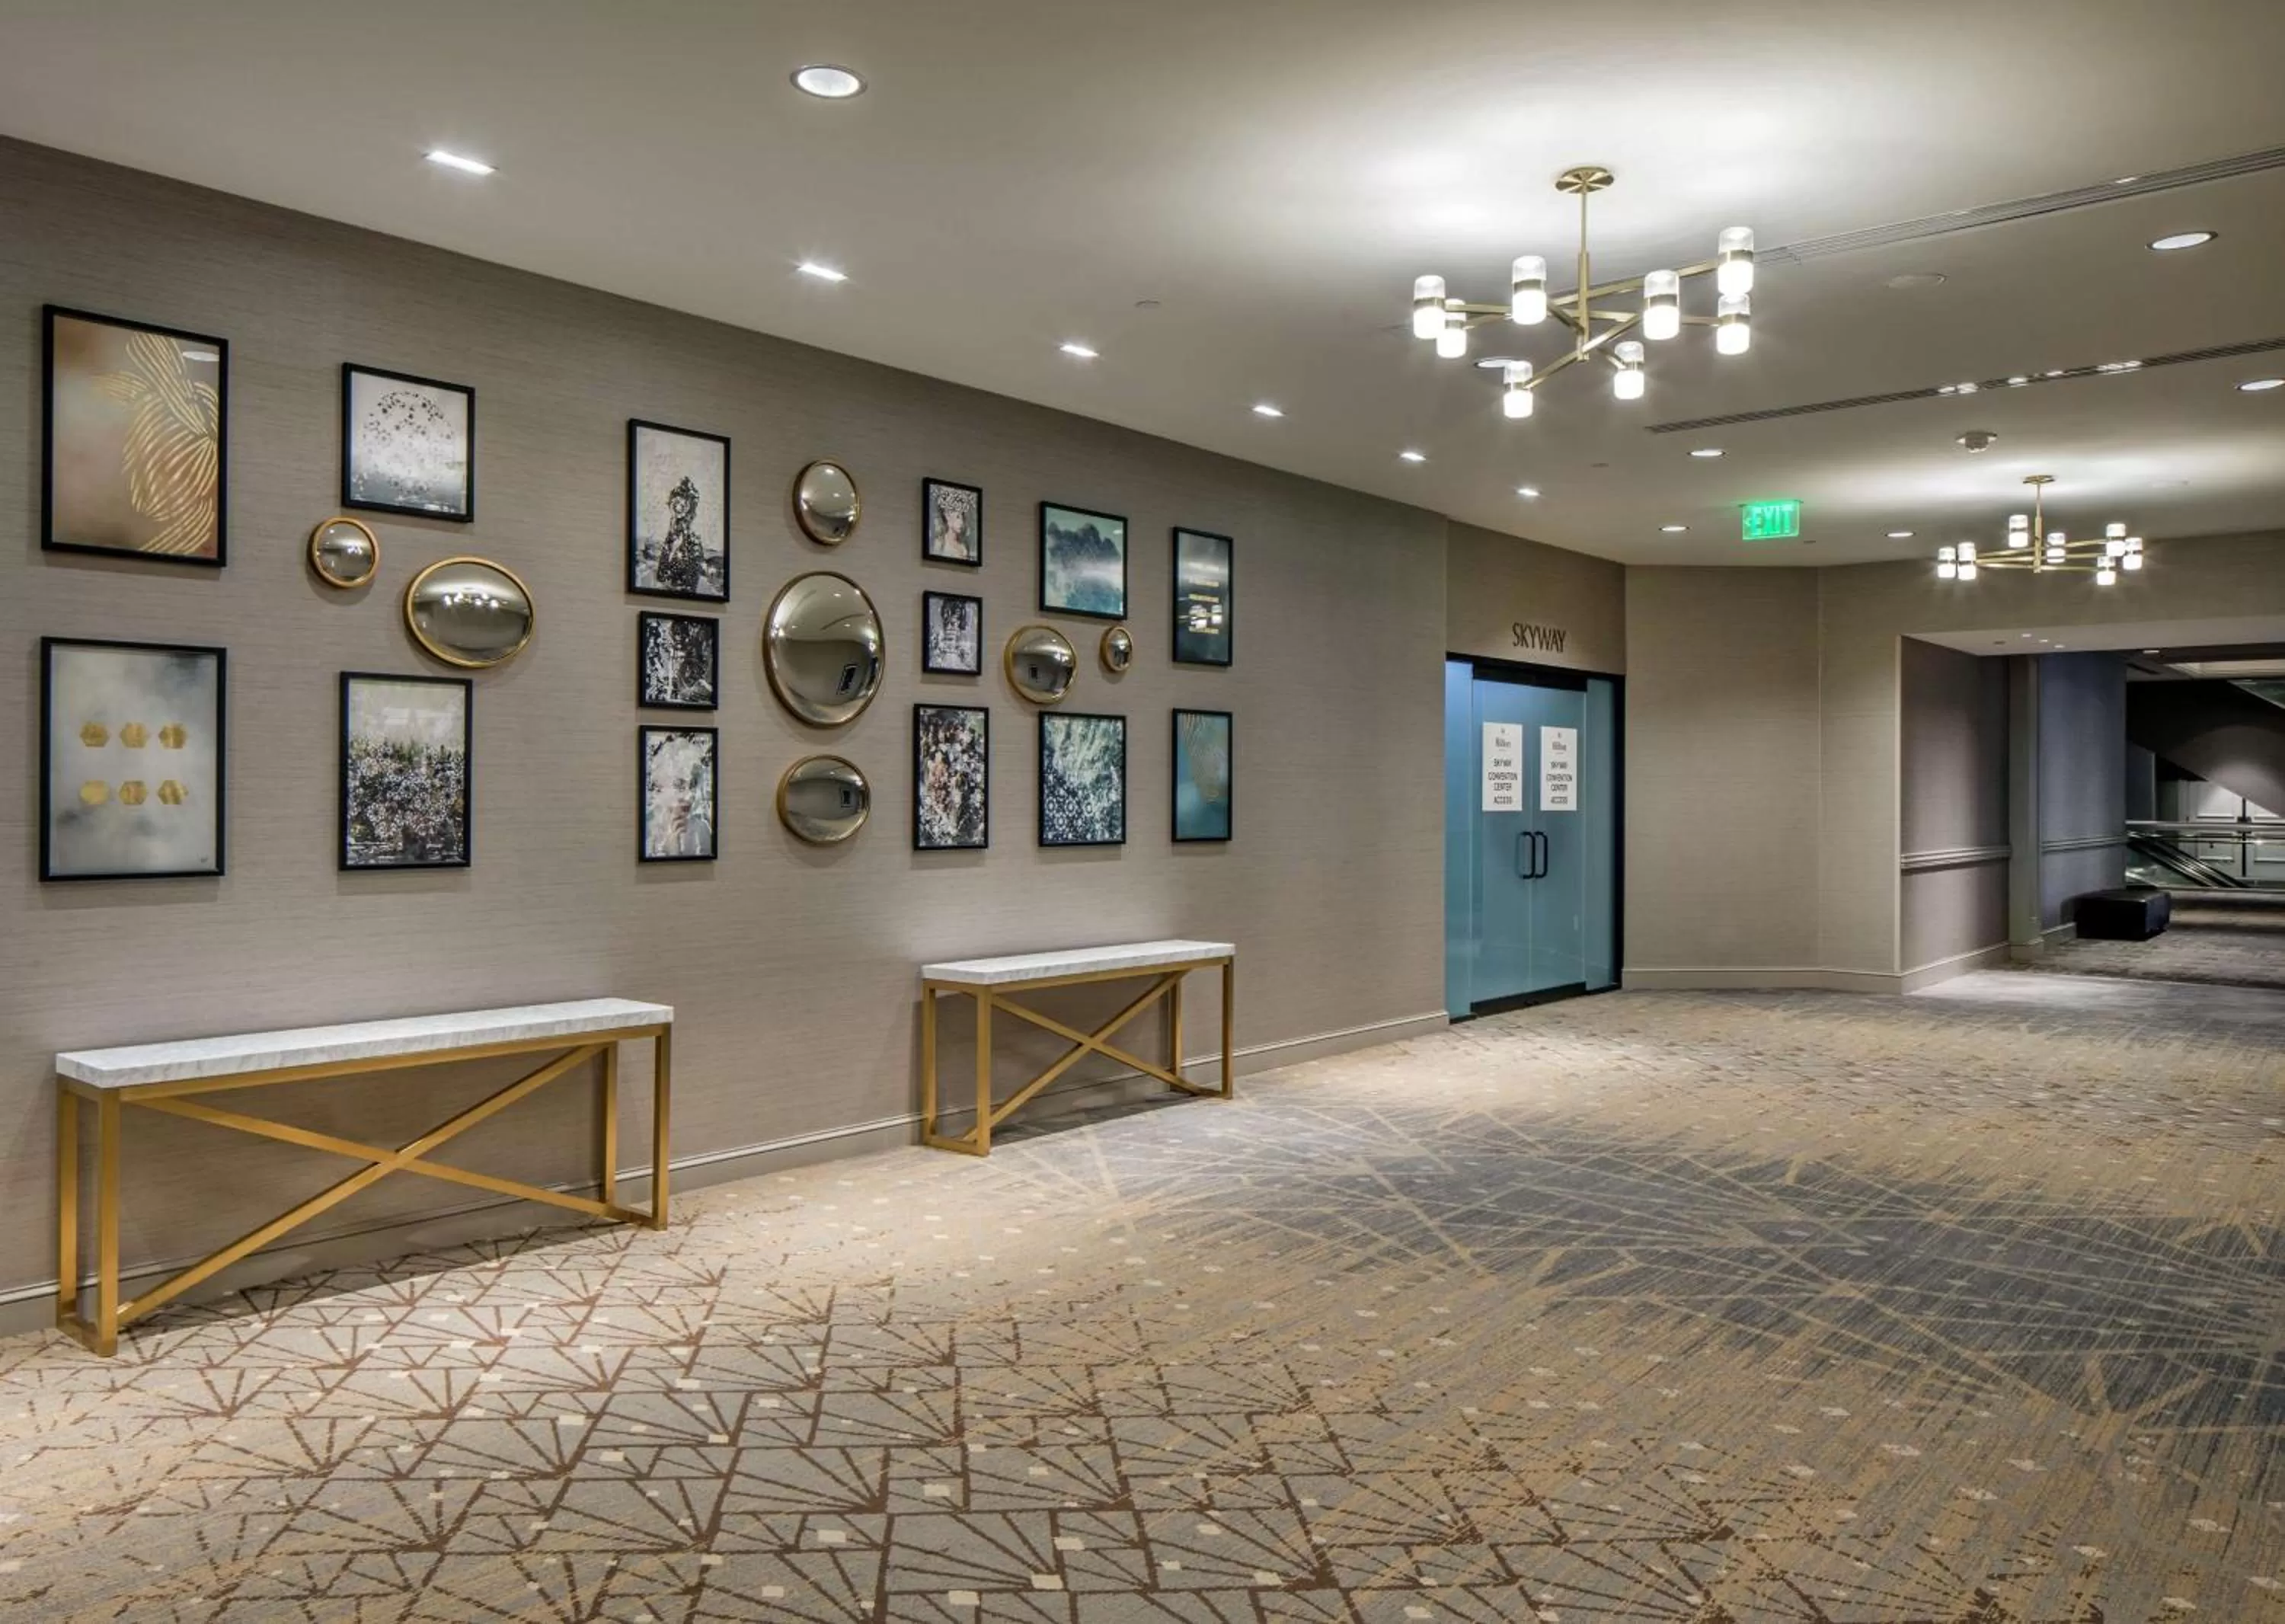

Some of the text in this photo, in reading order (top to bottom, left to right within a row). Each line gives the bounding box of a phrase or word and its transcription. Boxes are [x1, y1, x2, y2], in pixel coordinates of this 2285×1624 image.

[1752, 504, 1793, 535] EXIT
[1512, 622, 1567, 653] SKYWAY
[1488, 772, 1518, 781] CONVENTION
[1546, 773, 1573, 782] CONVENTION
[1493, 782, 1512, 791] CENTER
